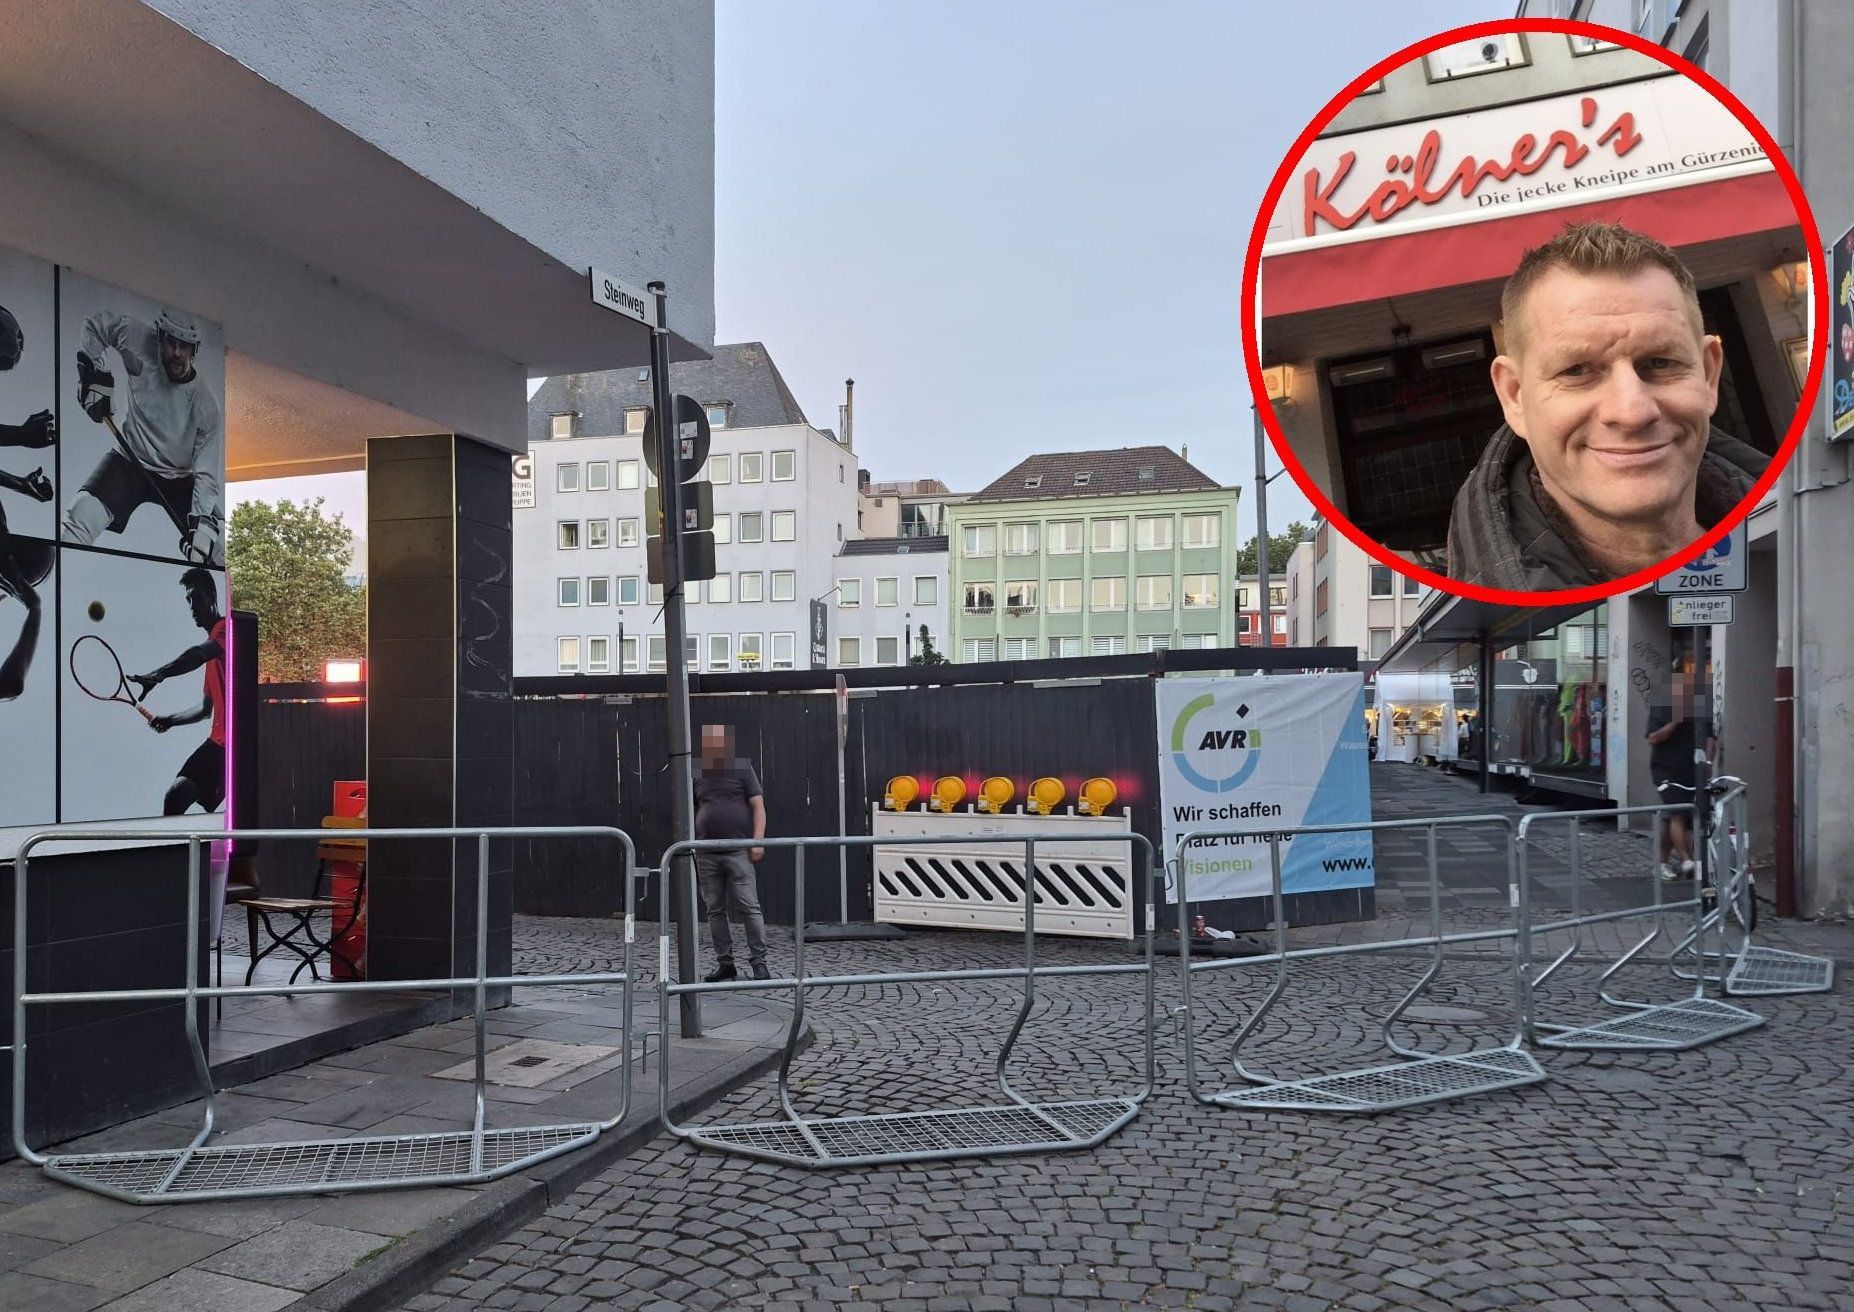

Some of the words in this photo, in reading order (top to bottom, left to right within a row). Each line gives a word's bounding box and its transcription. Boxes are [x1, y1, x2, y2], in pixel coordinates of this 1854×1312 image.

[1303, 97, 1643, 237] Kölner's
[1477, 187, 1511, 208] Die
[1515, 177, 1567, 203] jecke
[1573, 167, 1640, 190] Kneipe
[1645, 161, 1676, 176] am
[604, 279, 645, 319] Steinweg
[1679, 574, 1724, 588] ZONE
[1692, 611, 1712, 620] frei
[1199, 730, 1247, 751] AVR
[1173, 806, 1203, 822] Wir
[1208, 802, 1282, 821] schaffen
[1322, 857, 1374, 873] www.
